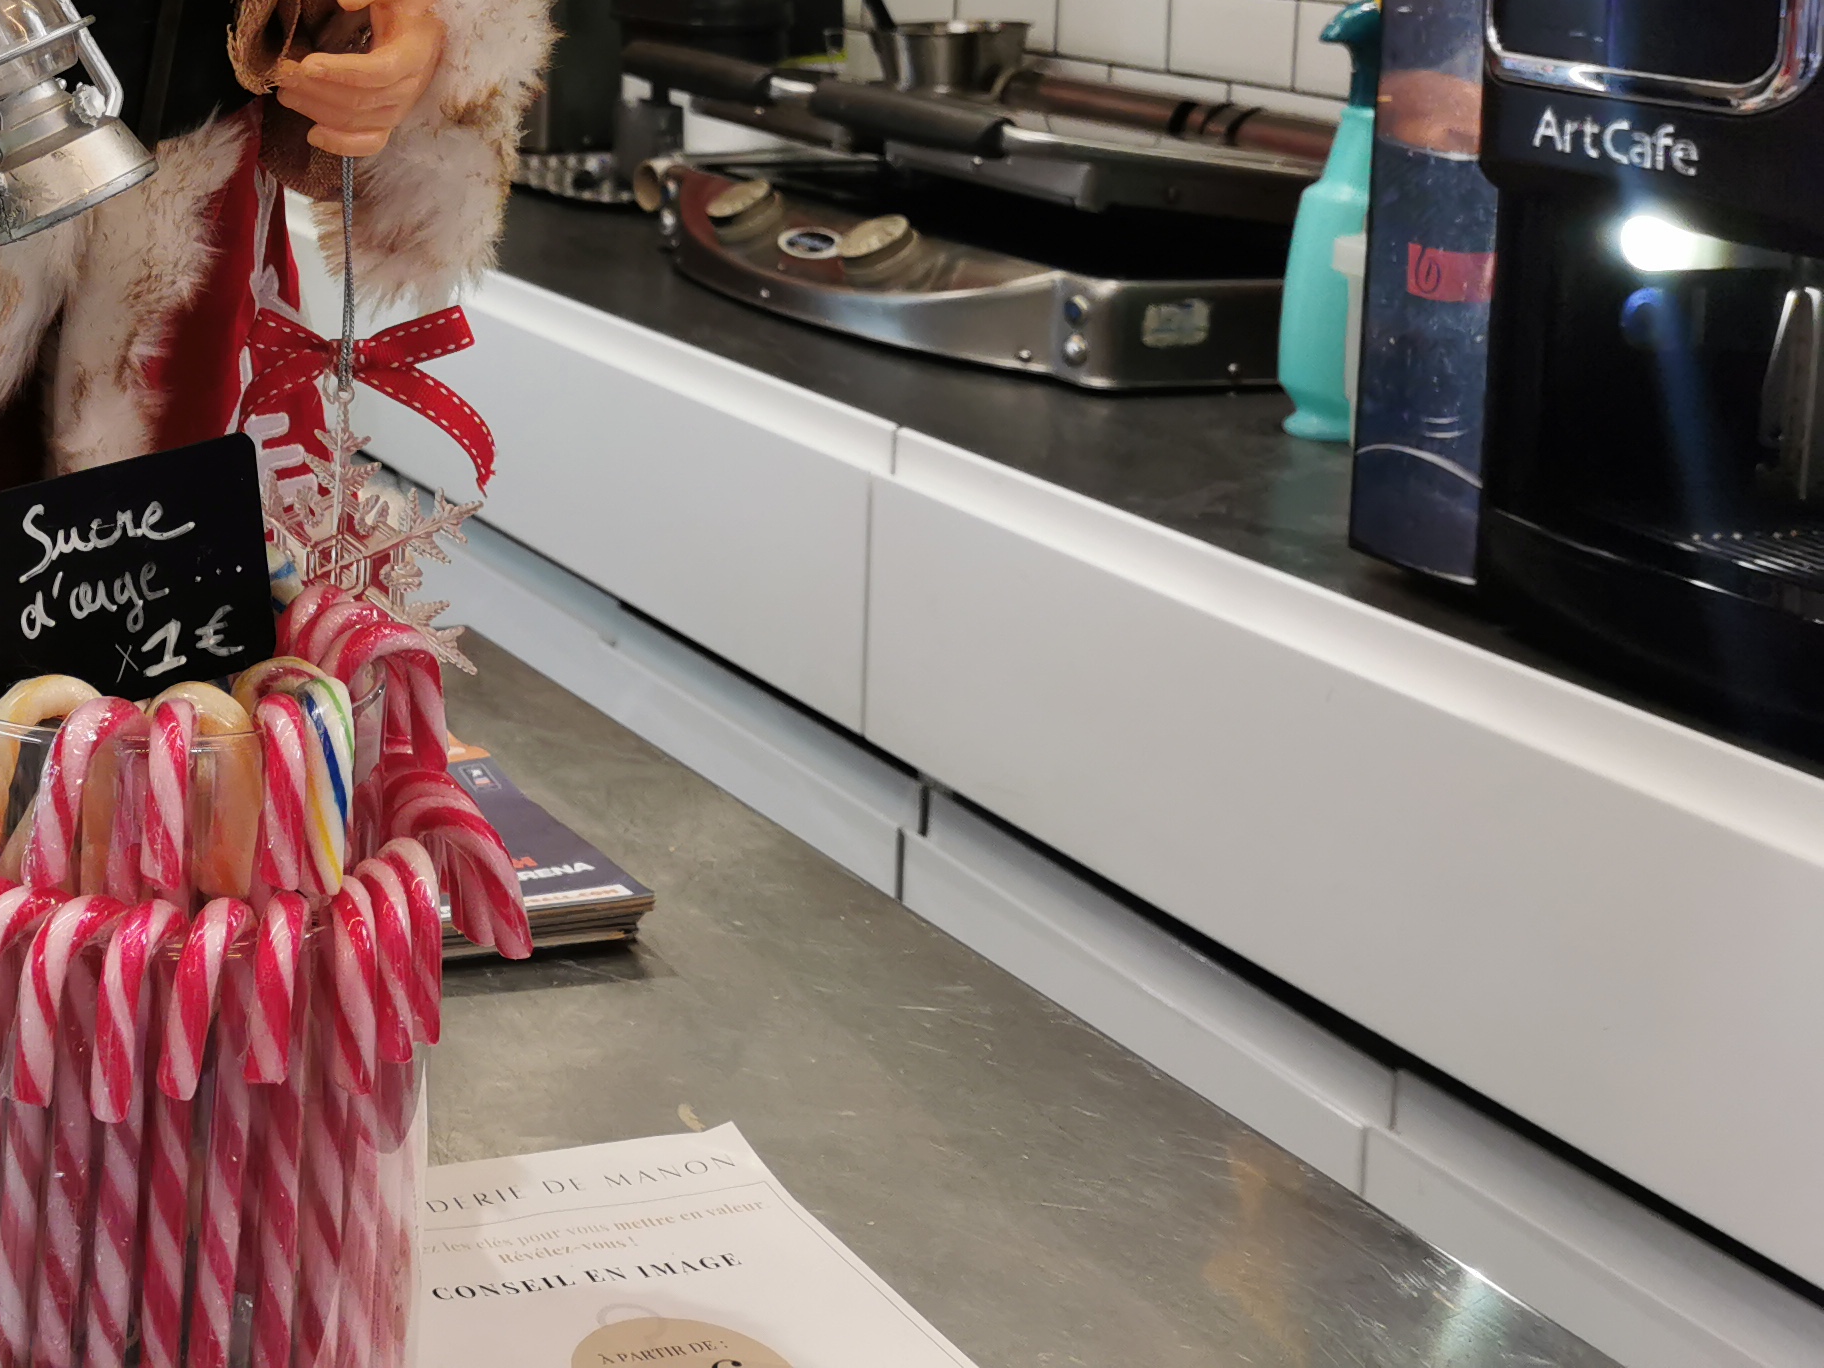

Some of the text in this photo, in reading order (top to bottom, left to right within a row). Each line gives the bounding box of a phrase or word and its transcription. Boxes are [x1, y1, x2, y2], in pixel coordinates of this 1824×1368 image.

[1532, 105, 1700, 177] ArtCafe
[19, 500, 196, 583] Sucre
[517, 861, 596, 882] RENA
[426, 1154, 738, 1214] DERIE DE MANON
[613, 1214, 676, 1231] mettre
[680, 1210, 704, 1222] en
[431, 1252, 743, 1301] CONSEIL EN IMAGE
[616, 1344, 686, 1364] PARTIR
[689, 1340, 717, 1355] DE
